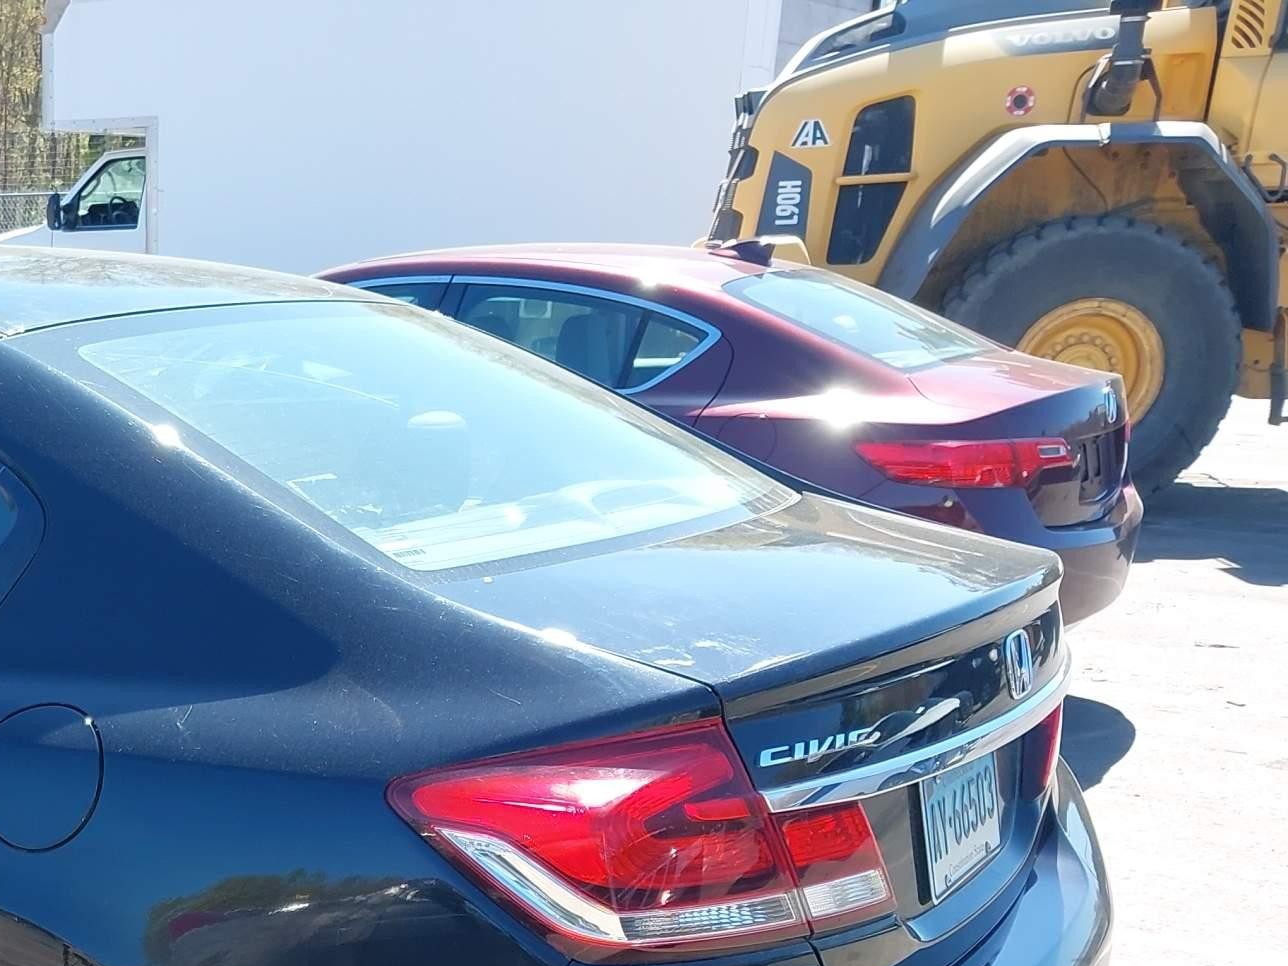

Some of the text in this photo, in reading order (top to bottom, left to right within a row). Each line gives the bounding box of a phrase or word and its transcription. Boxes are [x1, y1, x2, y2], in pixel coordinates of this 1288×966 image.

[1005, 26, 1116, 48] VOLVO
[774, 180, 802, 226] L90H
[758, 726, 881, 768] CIVIC
